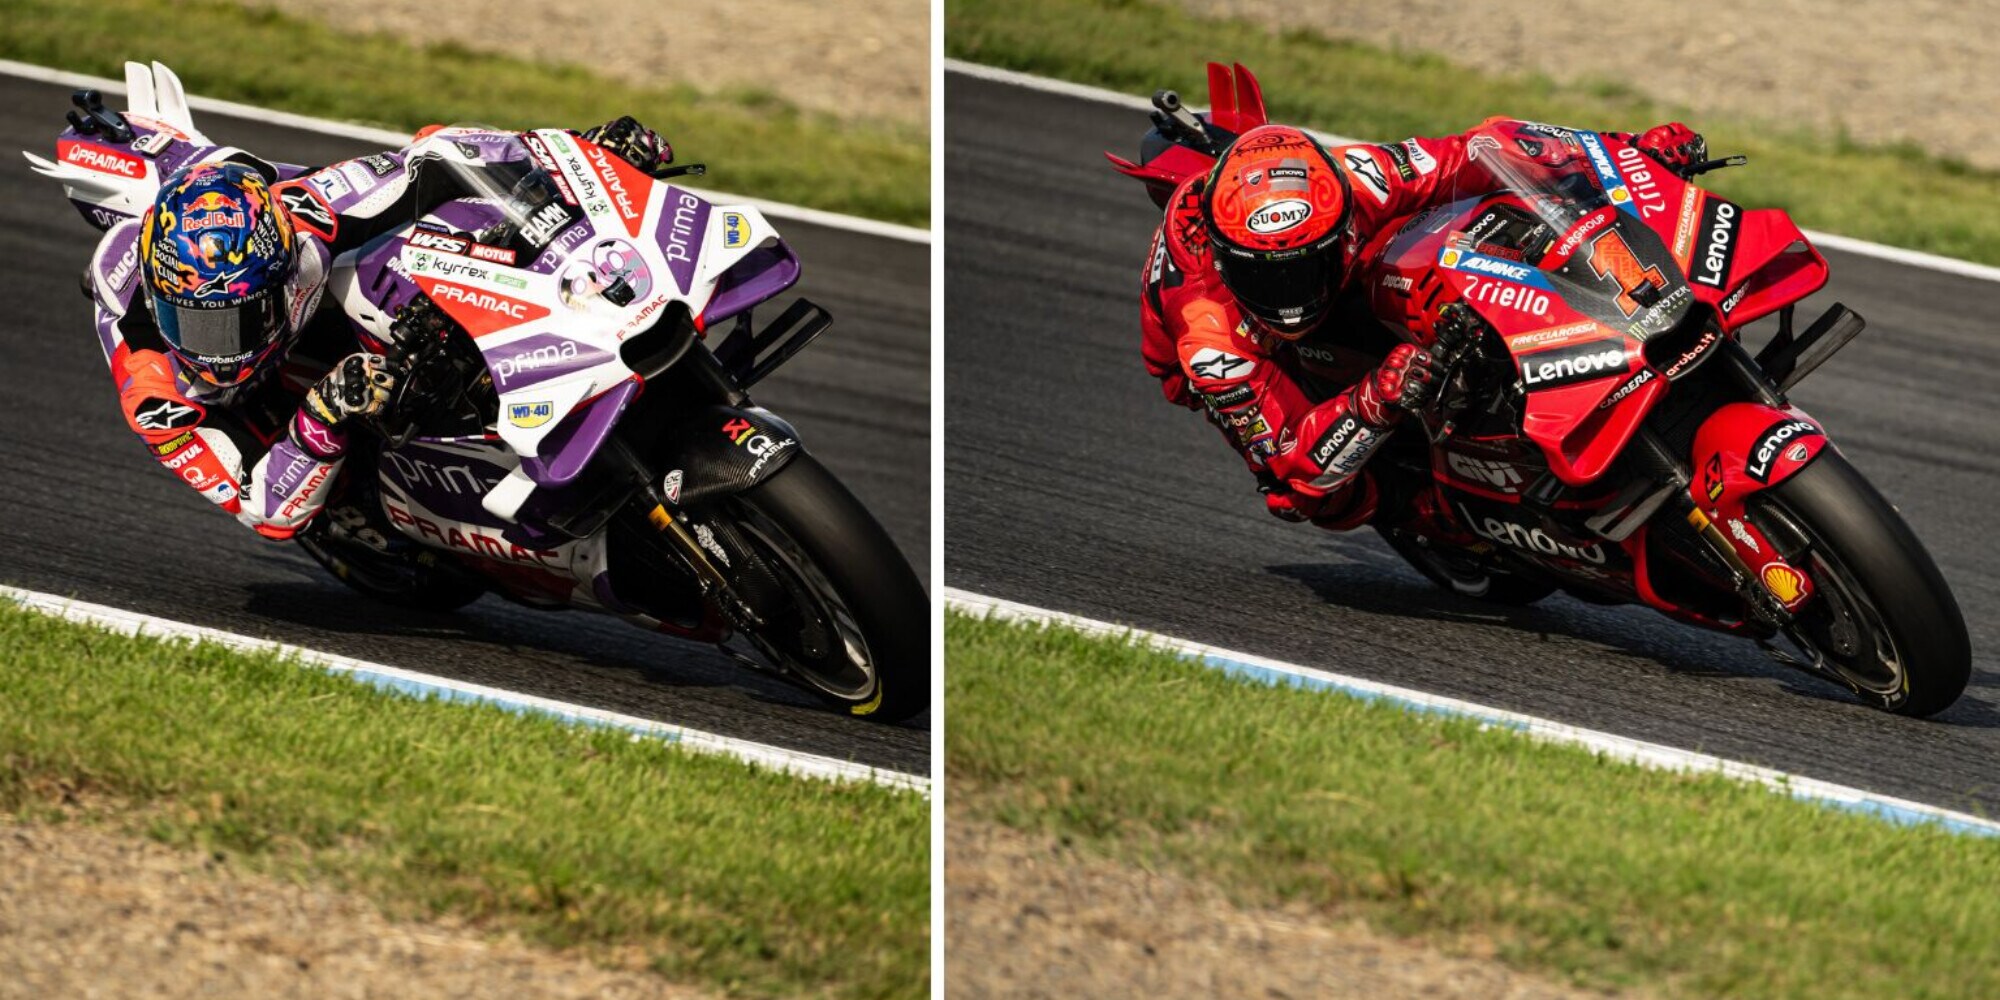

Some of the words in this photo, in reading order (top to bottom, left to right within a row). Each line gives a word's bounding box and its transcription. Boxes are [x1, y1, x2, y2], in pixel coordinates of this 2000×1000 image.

[77, 149, 138, 176] PRAMAC
[587, 146, 640, 220] PRAMAC
[1270, 169, 1306, 177] Lenovo
[182, 211, 212, 233] Red
[213, 211, 246, 229] Bull
[519, 202, 570, 245] FIAMM
[665, 192, 698, 263] prima
[1251, 206, 1307, 227] SUOMY
[1557, 213, 1605, 257] VARGROUP
[409, 232, 467, 253] WRS
[471, 245, 514, 263] MOTUL
[1697, 203, 1735, 286] Lenovo
[107, 236, 139, 291] DUCA
[433, 257, 488, 280] kyrrex
[1459, 256, 1532, 281] ADVANCE
[1587, 227, 1670, 320] 1
[165, 294, 195, 307] GIVES
[201, 300, 226, 308] YOU
[231, 288, 268, 305] WINGS
[431, 283, 528, 320] PRAMAC
[1640, 285, 1691, 328] MONSTER
[1510, 321, 1599, 348] FRECCIAROSSA
[1665, 331, 1716, 377] aruba.it
[491, 340, 578, 386] prima
[1522, 349, 1626, 385] Lenovo
[1600, 369, 1653, 410] CARRERA
[512, 404, 550, 418] WD-40
[749, 438, 797, 479] PRAMAC
[1316, 418, 1357, 464] Lenovo
[1749, 420, 1815, 478] Lenovo
[272, 455, 312, 499] prima
